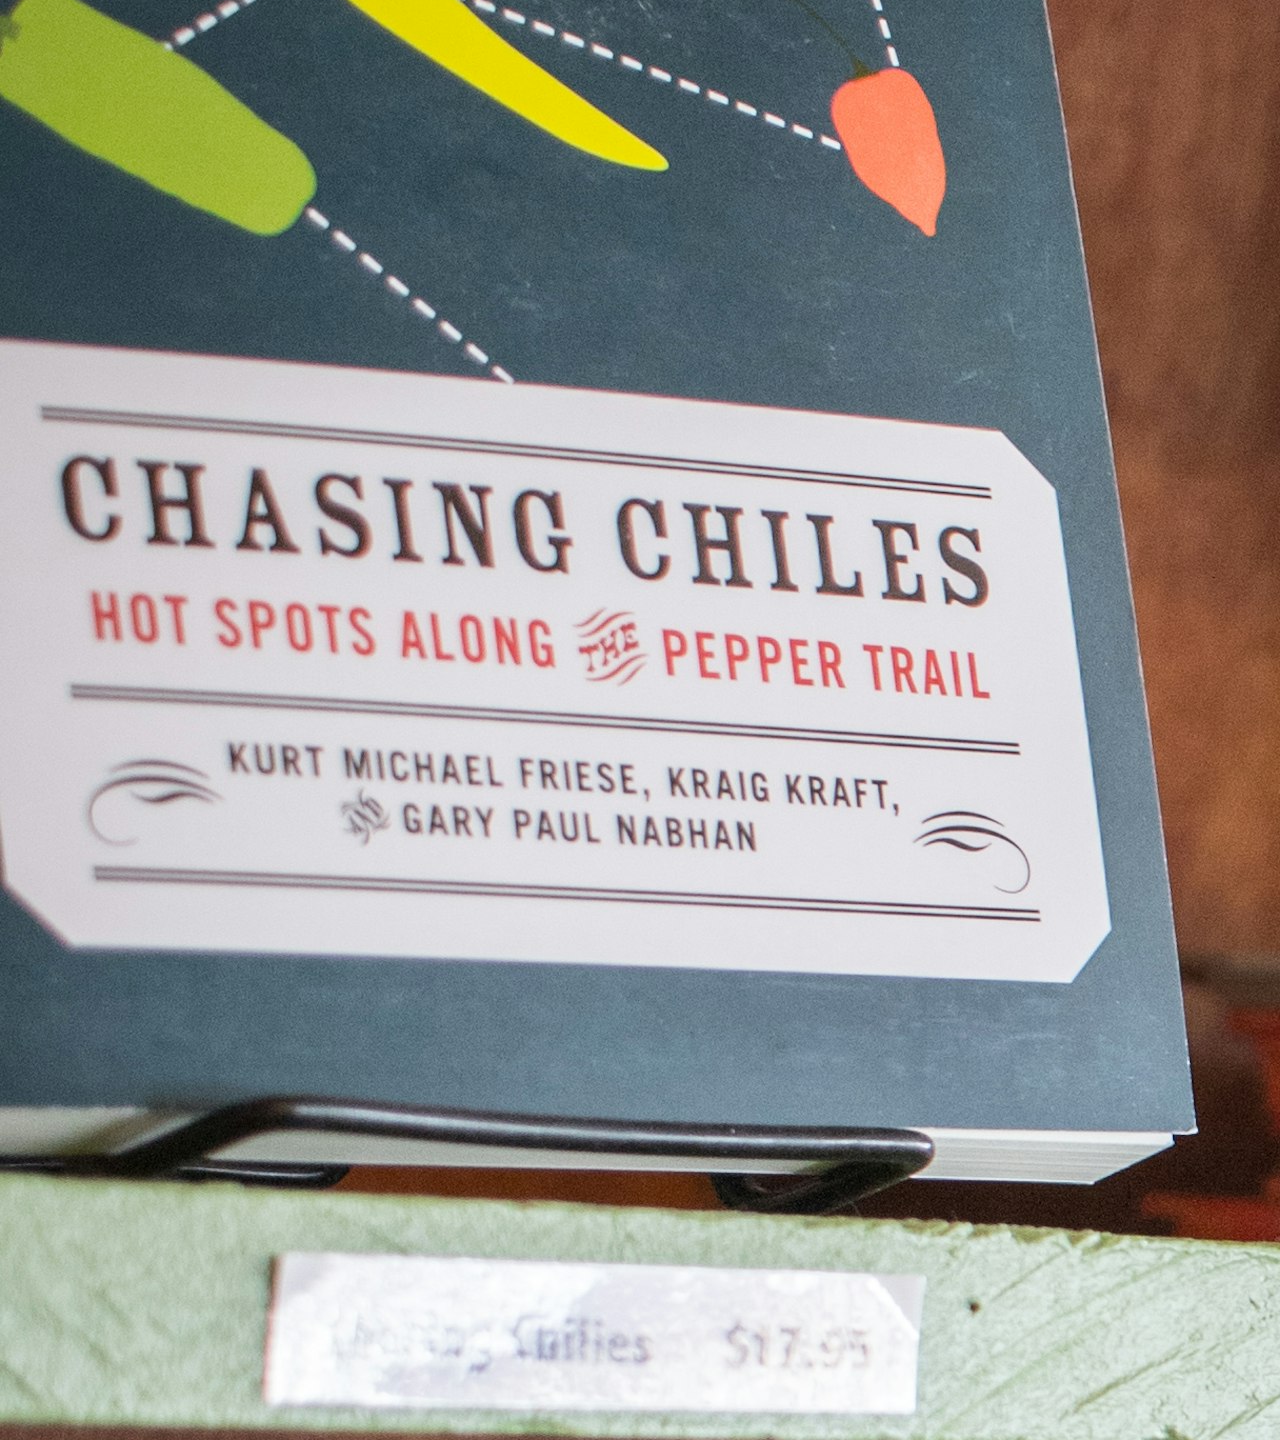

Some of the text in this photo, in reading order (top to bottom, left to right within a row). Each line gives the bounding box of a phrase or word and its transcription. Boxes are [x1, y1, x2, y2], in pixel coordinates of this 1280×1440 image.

[60, 453, 992, 610] CHASING CHILES
[90, 590, 991, 700] HOT SPOTS ALONG THE PEPPER TRAIL
[227, 741, 900, 816] KURT MICHAEL FRIESE, KRAIG KRAFT,
[402, 803, 496, 839] GARY
[513, 809, 602, 844] PAUL
[617, 816, 757, 853] NABHAN
